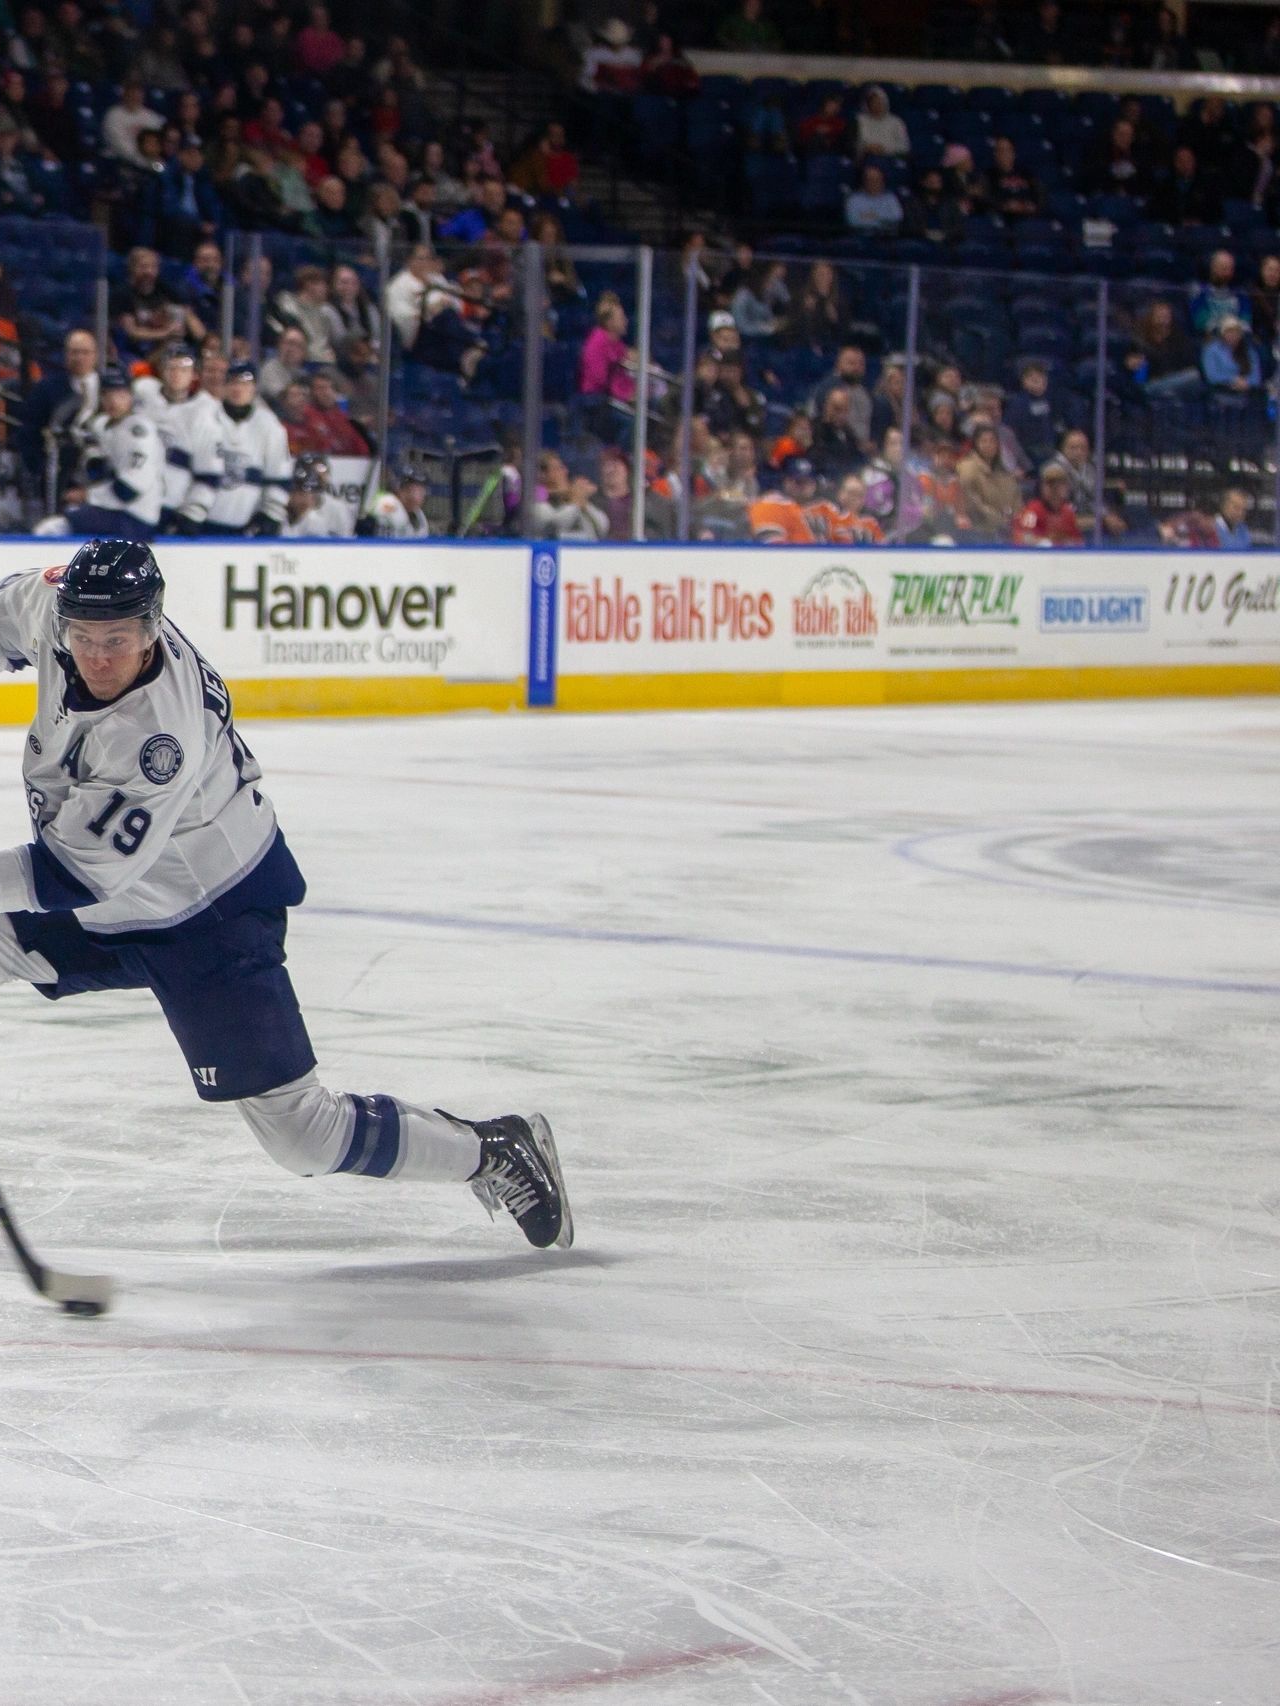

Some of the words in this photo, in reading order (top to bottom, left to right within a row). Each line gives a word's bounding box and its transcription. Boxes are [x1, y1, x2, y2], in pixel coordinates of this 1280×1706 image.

[88, 564, 110, 576] 19
[1164, 571, 1217, 615] 110
[223, 564, 456, 630] Hanover
[564, 577, 641, 642] Table
[651, 576, 705, 642] Talk
[712, 581, 775, 640] Pies
[793, 592, 839, 637] Table
[843, 591, 878, 638] Talk
[1042, 595, 1082, 625] BUD
[1086, 595, 1144, 625] LIGHT
[264, 635, 371, 664] Insurance
[61, 733, 86, 780] A
[86, 788, 153, 857] 19
